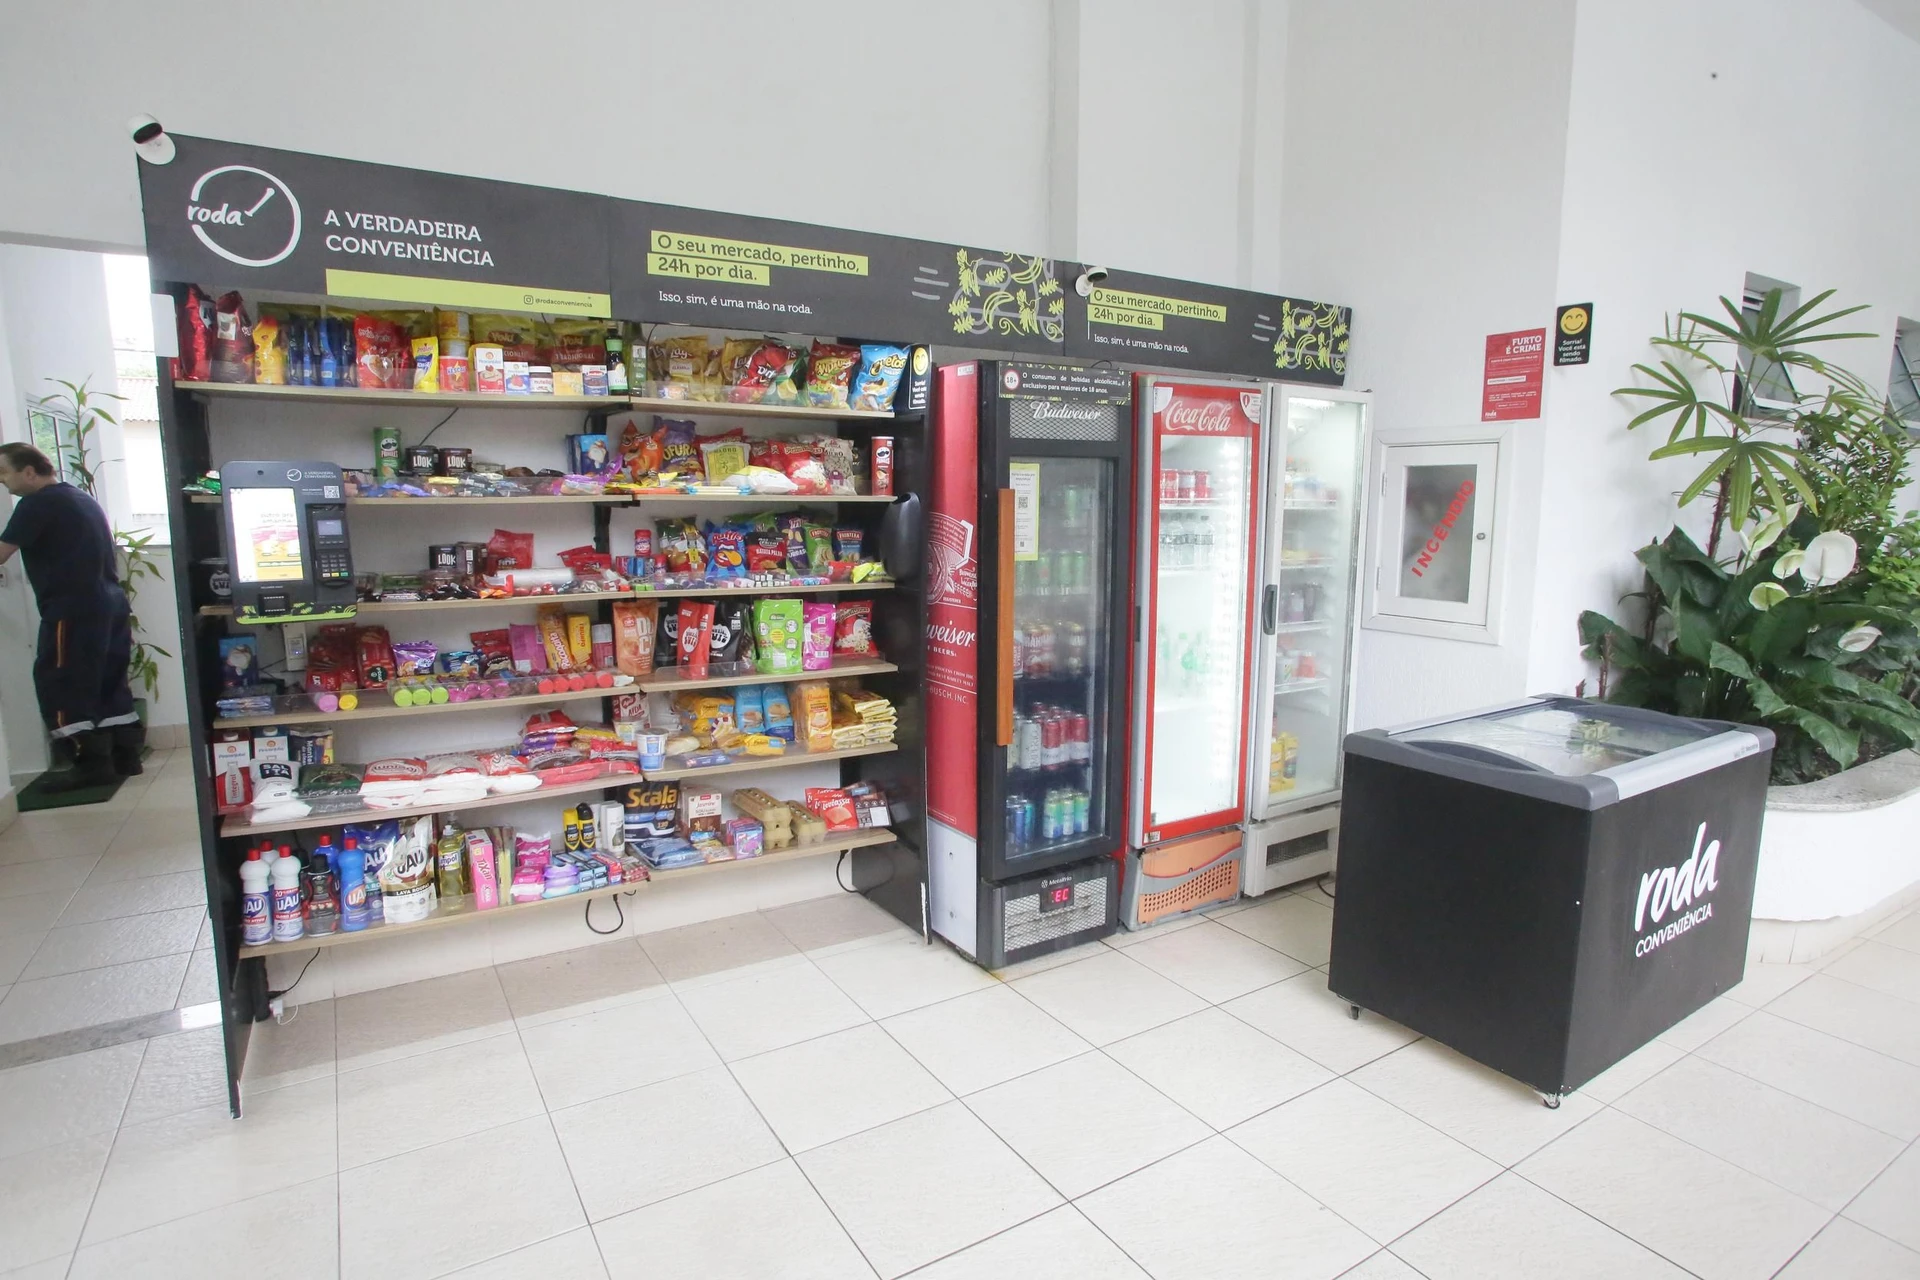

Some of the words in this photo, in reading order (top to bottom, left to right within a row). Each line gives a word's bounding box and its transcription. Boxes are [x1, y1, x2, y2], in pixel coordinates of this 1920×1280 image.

[187, 201, 244, 226] roda
[324, 210, 340, 226] A
[344, 212, 482, 242] VERDADEIRA
[325, 234, 494, 267] CONVENIÊNCIA
[658, 234, 671, 249] O
[677, 239, 706, 254] seu
[711, 243, 786, 264] mercado,
[791, 251, 859, 272] pertinho,
[658, 257, 690, 273] 24h
[695, 263, 723, 280] por
[729, 264, 757, 281] dia.
[659, 291, 683, 304] Isso,
[686, 293, 708, 306] sim,
[711, 295, 717, 306] é
[720, 298, 744, 308] uma
[747, 299, 770, 311] mão
[772, 302, 786, 312] na
[788, 302, 812, 314] roda.
[1094, 290, 1103, 302] O
[1106, 294, 1125, 306] seu
[1127, 295, 1174, 314] mercado,
[1177, 301, 1221, 320] pertinho,
[1094, 308, 1113, 320] 24h
[1116, 312, 1134, 326] por
[1137, 312, 1156, 327] dia.
[1094, 334, 1110, 345] Isso,
[1111, 335, 1125, 346] sim,
[1131, 340, 1147, 348] uma
[1148, 341, 1163, 351] mão
[1164, 343, 1172, 351] na
[1173, 344, 1189, 354] roda.
[1506, 346, 1511, 354] É
[1513, 343, 1542, 354] CRIME
[1512, 335, 1542, 346] FURTO
[1030, 400, 1102, 420] Budweiser
[413, 455, 432, 467] LOOK
[447, 455, 466, 467] LOOK
[1412, 479, 1475, 578] INCÊNDIO
[438, 554, 457, 566] LOOK
[626, 787, 678, 808] Scala
[364, 845, 388, 869] AU
[1634, 821, 1720, 933] roda
[276, 892, 300, 912] UAU
[396, 888, 411, 897] LAVA
[1635, 903, 1713, 958] CONVENIÊNCIA
